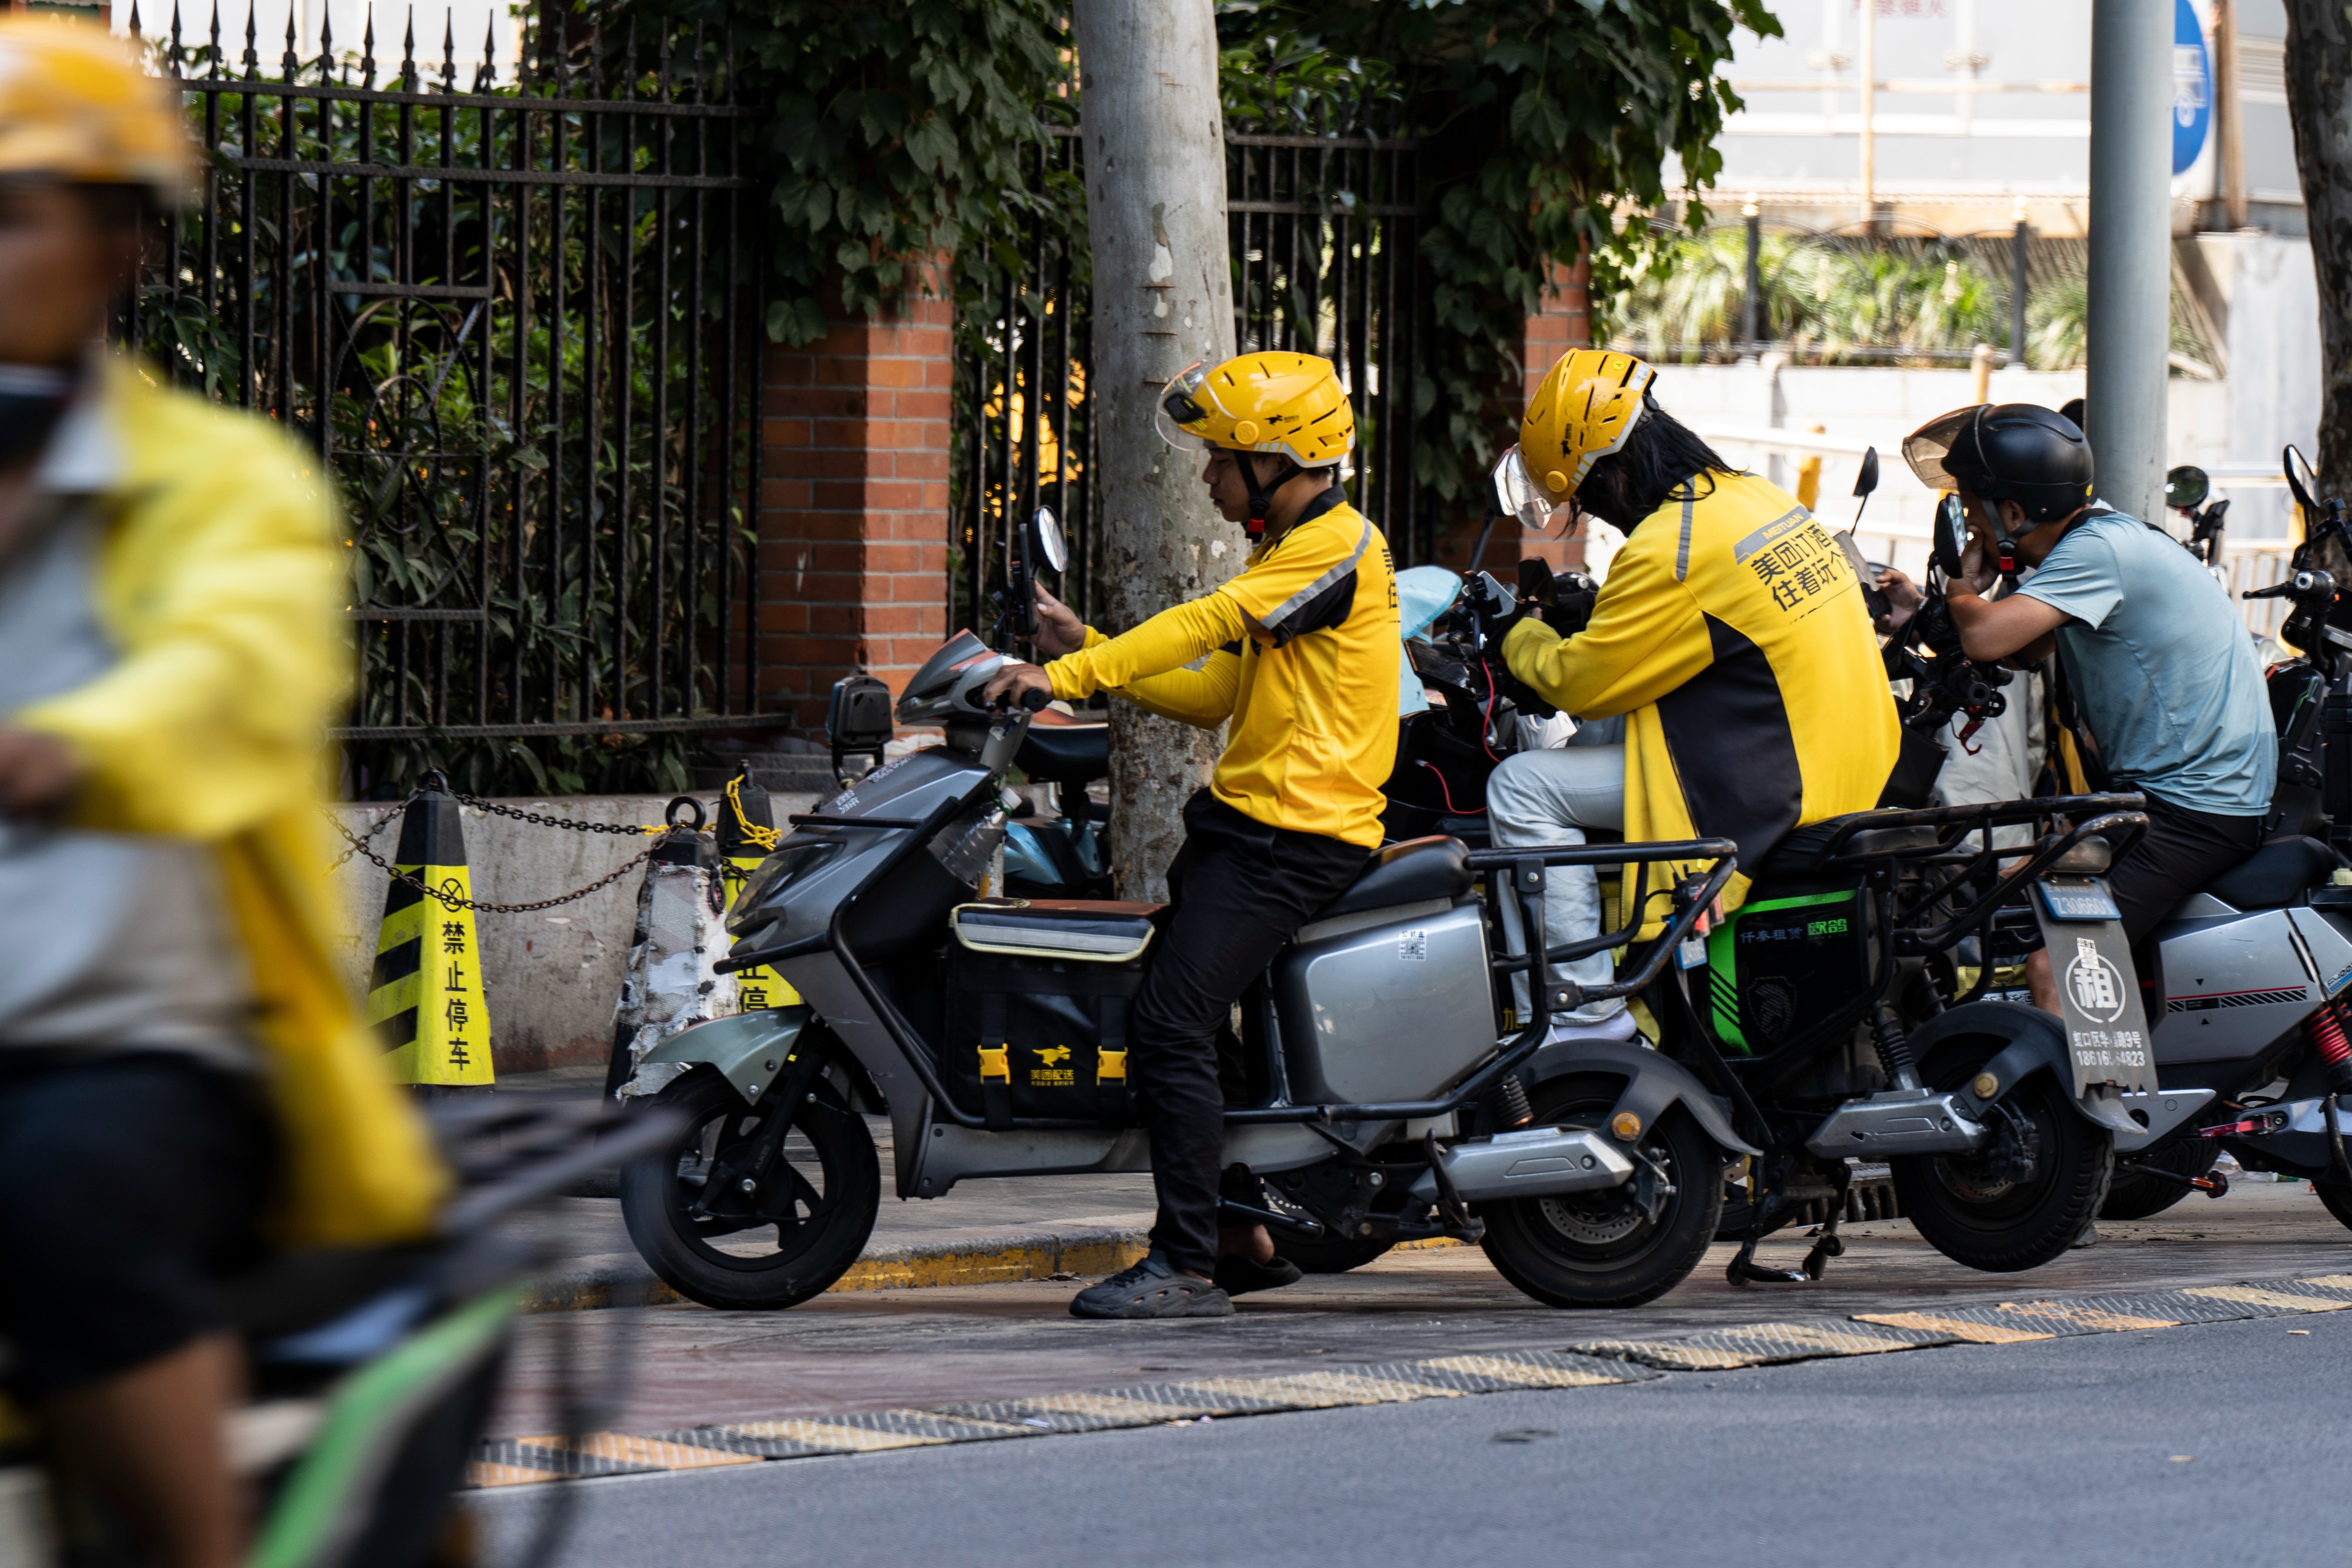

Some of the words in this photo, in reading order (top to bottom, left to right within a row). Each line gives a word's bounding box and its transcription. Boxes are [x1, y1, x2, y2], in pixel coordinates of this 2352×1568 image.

[1762, 513, 1804, 540] MEITUAN
[442, 921, 470, 1071] 禁止停车
[2073, 967, 2118, 1008] 租
[1030, 1069, 1074, 1081] 美团配送
